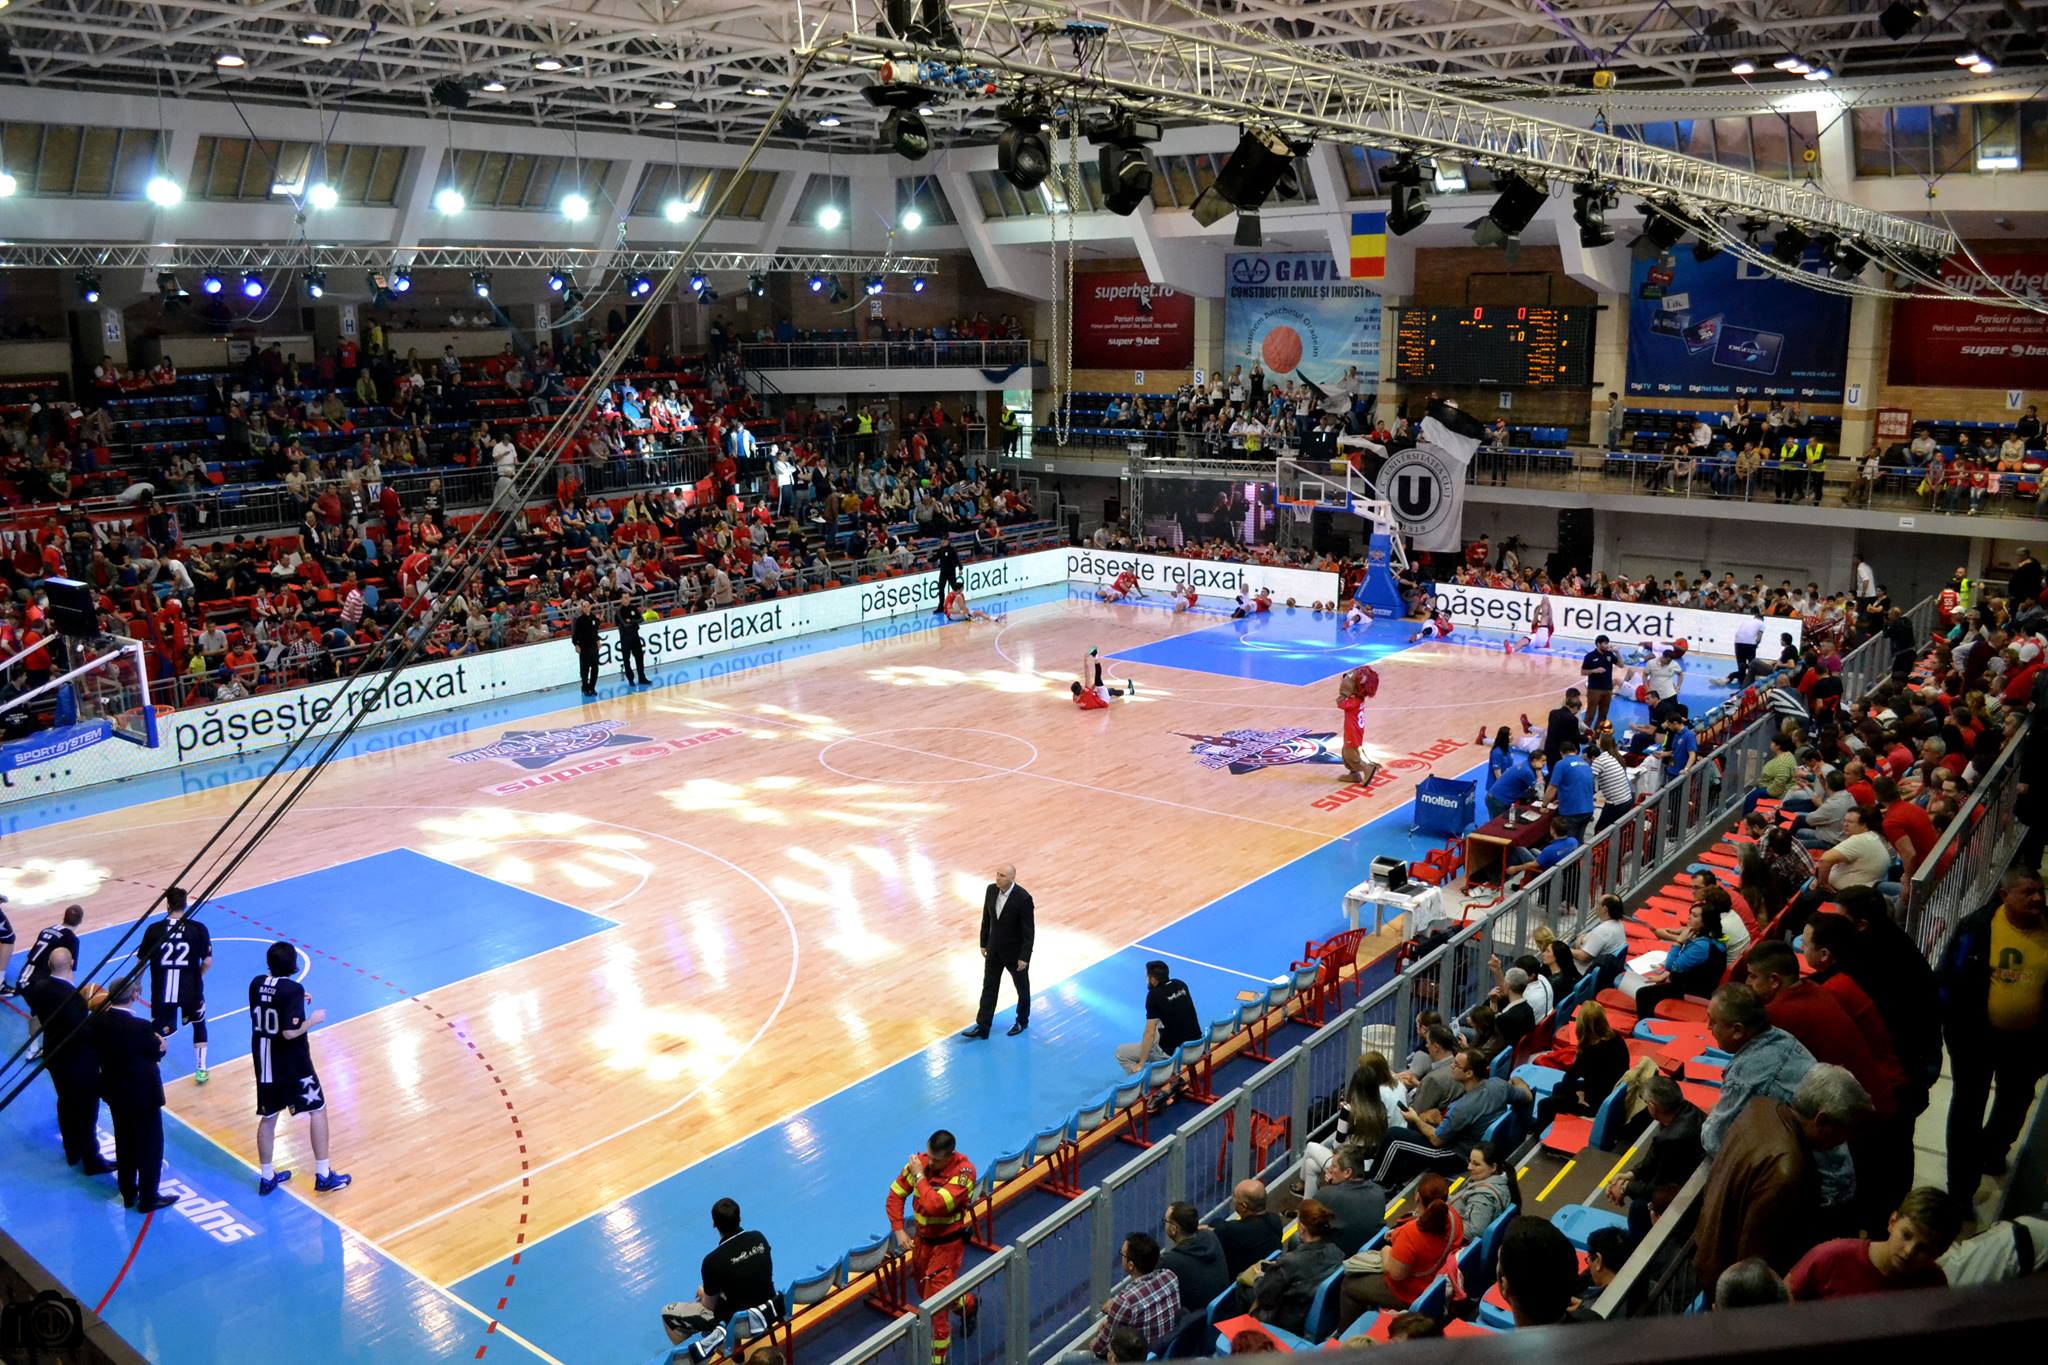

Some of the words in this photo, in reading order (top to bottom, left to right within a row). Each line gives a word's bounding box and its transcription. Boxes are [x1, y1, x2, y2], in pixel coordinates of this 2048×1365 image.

[1094, 282, 1175, 301] superbet.ro
[1231, 286, 1289, 299] CONSTRUCȚII
[1290, 286, 1318, 298] CIVILE
[1320, 286, 1330, 300] ȘI
[1474, 307, 1484, 321] 0
[1518, 307, 1528, 321] 0
[1975, 314, 2010, 324] Pariuri
[1107, 337, 1134, 347] super
[1144, 336, 1161, 346] bet
[1960, 345, 2009, 358] super
[2025, 345, 2048, 356] be
[1136, 372, 1143, 384] R
[1195, 371, 1202, 384] S
[1502, 394, 1510, 406] T
[1849, 389, 1858, 404] U
[2009, 393, 2021, 407] V
[1384, 453, 1445, 477] UNIVERSITATEA
[1442, 475, 1451, 498] CLUJ
[1398, 475, 1432, 516] U
[1164, 562, 1245, 590] relaxat
[699, 604, 782, 645] relaxat
[1564, 603, 1674, 639] relaxat
[348, 664, 467, 716] relaxat
[15, 728, 102, 763] SPORTSYSTEM
[1408, 738, 1469, 761] bet
[496, 755, 624, 795] super
[669, 727, 744, 749] bet
[1421, 793, 1458, 809] molten
[36, 940, 49, 962] 7
[160, 942, 189, 966] 22
[253, 1005, 279, 1034] 10
